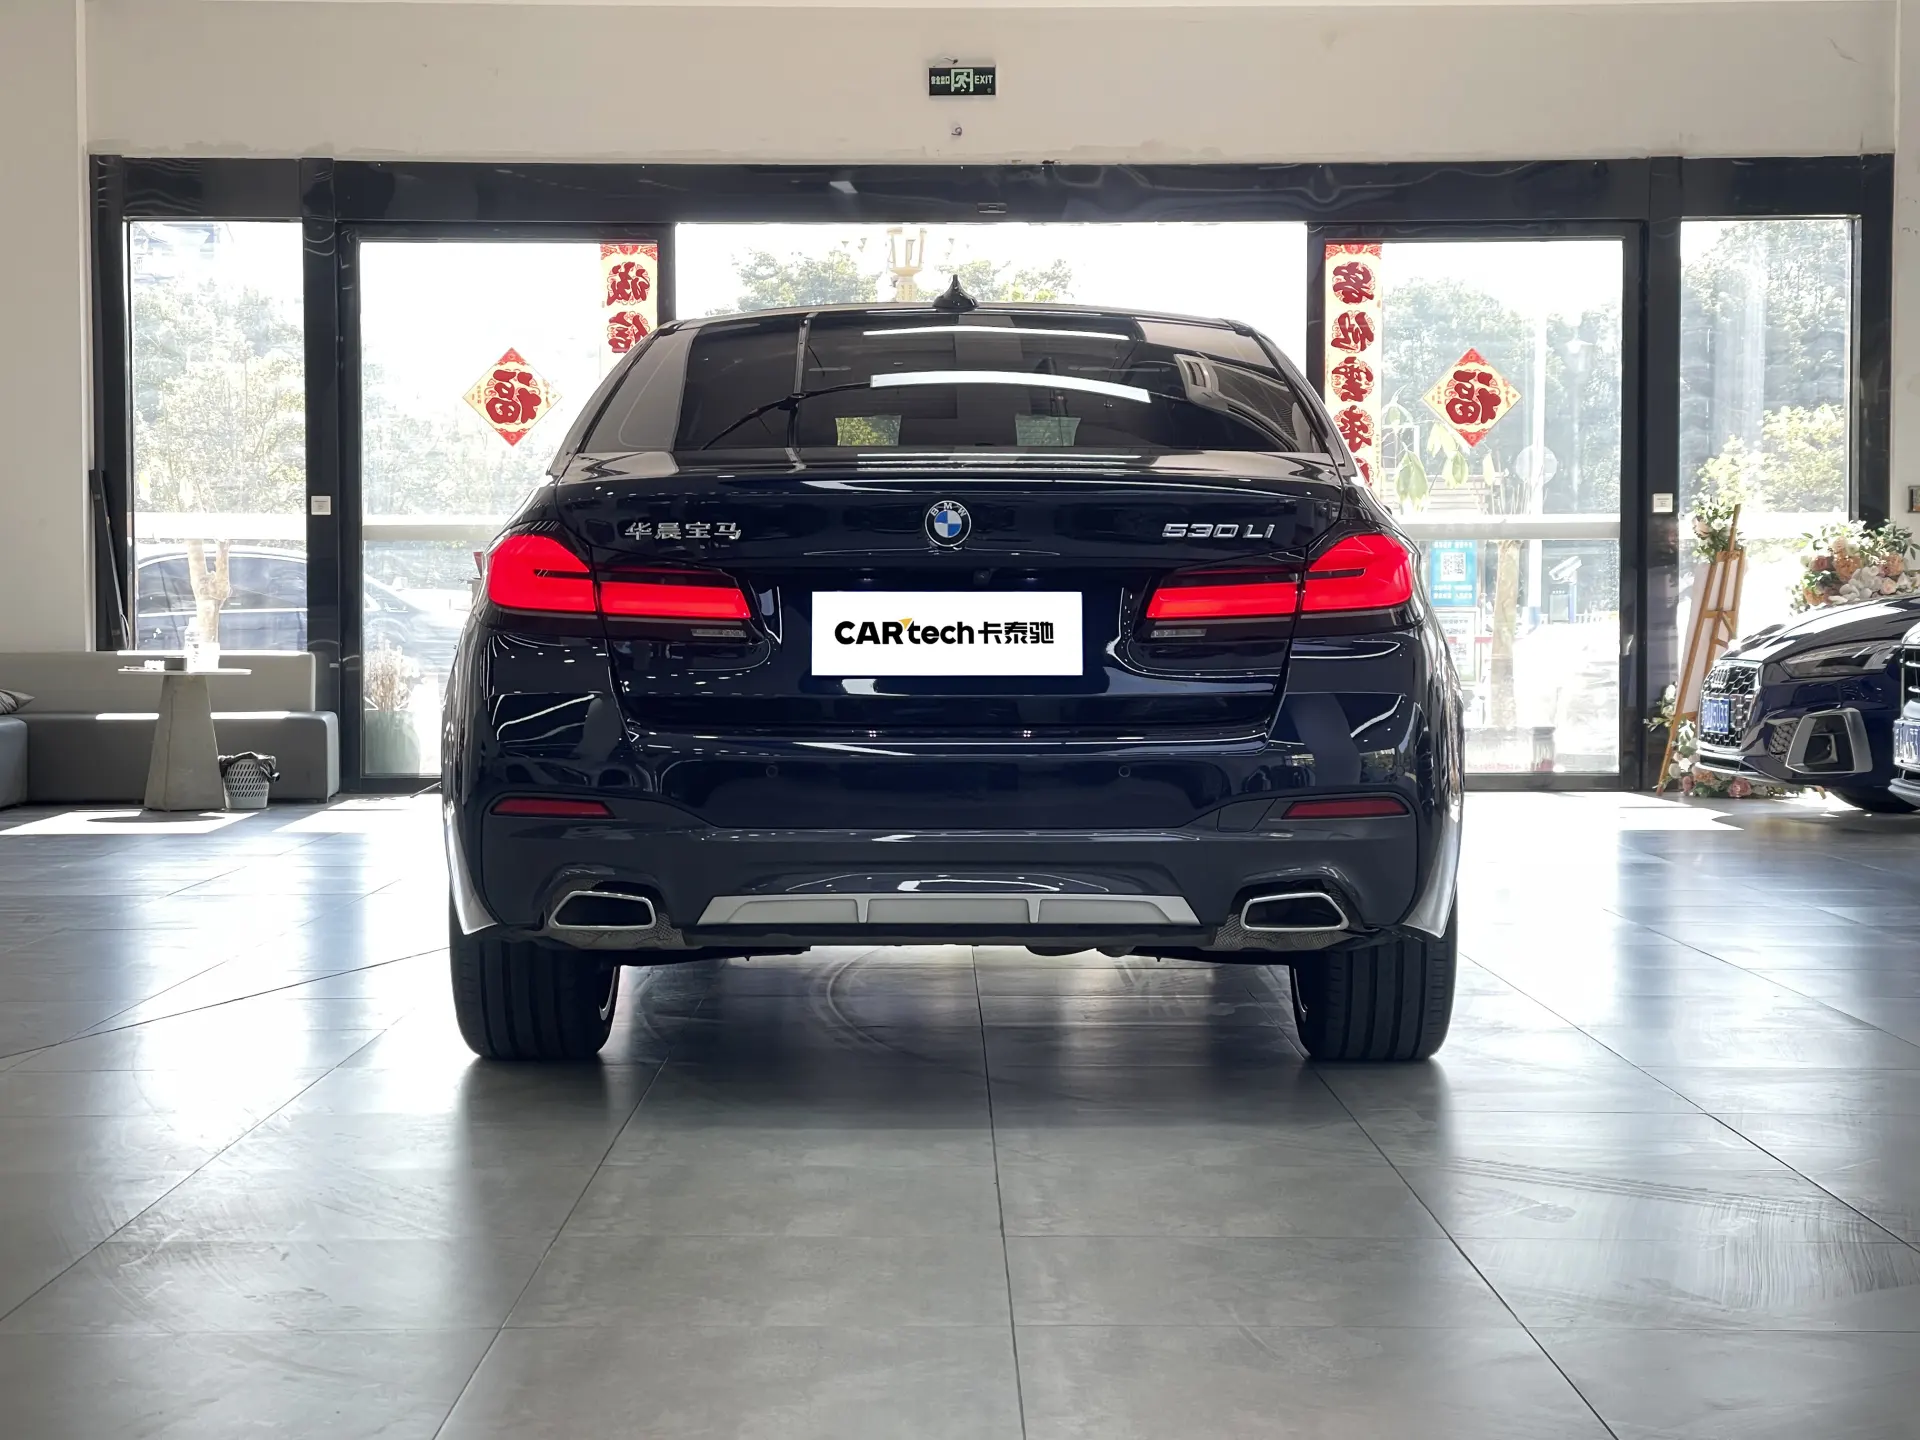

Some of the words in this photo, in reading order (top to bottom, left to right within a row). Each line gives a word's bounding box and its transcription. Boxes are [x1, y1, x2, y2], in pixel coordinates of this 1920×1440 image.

[974, 75, 993, 84] EXIT
[930, 502, 967, 517] BMW
[624, 521, 742, 541] 华晨宝马
[1161, 523, 1239, 538] 530
